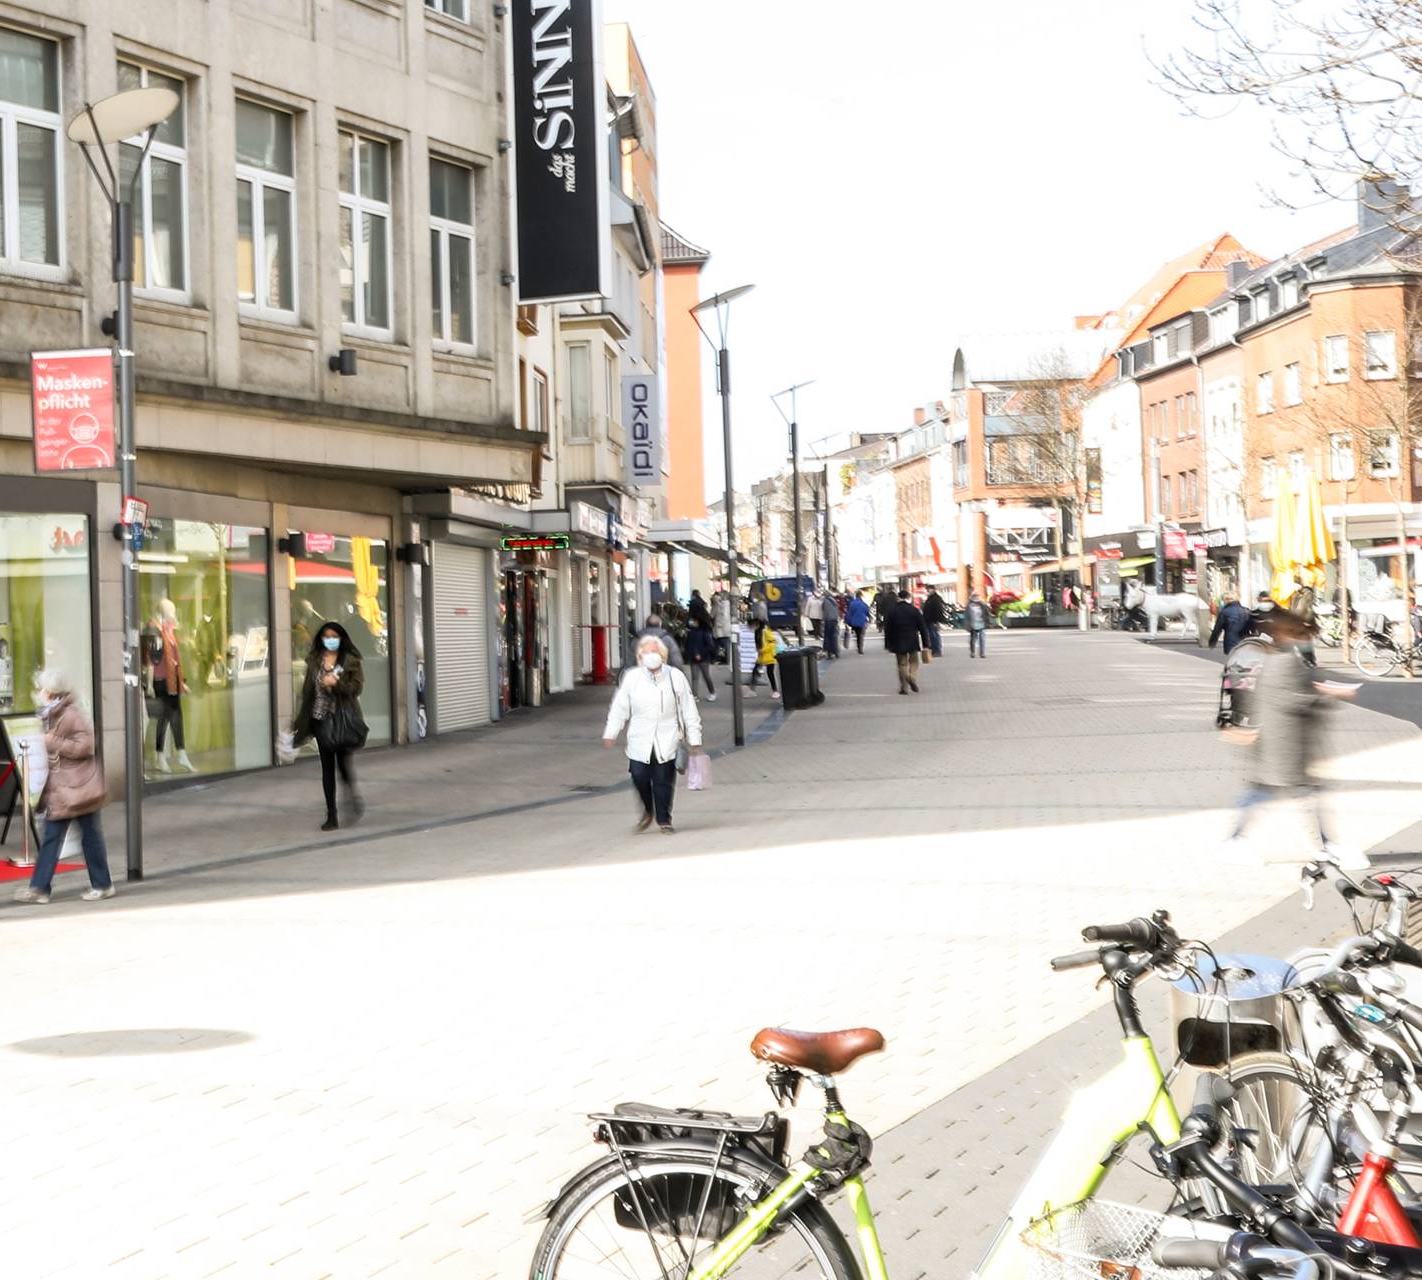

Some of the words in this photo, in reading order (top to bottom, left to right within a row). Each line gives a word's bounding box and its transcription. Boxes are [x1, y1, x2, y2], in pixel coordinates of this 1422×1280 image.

[547, 152, 564, 178] das
[564, 152, 576, 193] macht
[37, 373, 108, 391] Masken-
[38, 393, 91, 413] pflicht
